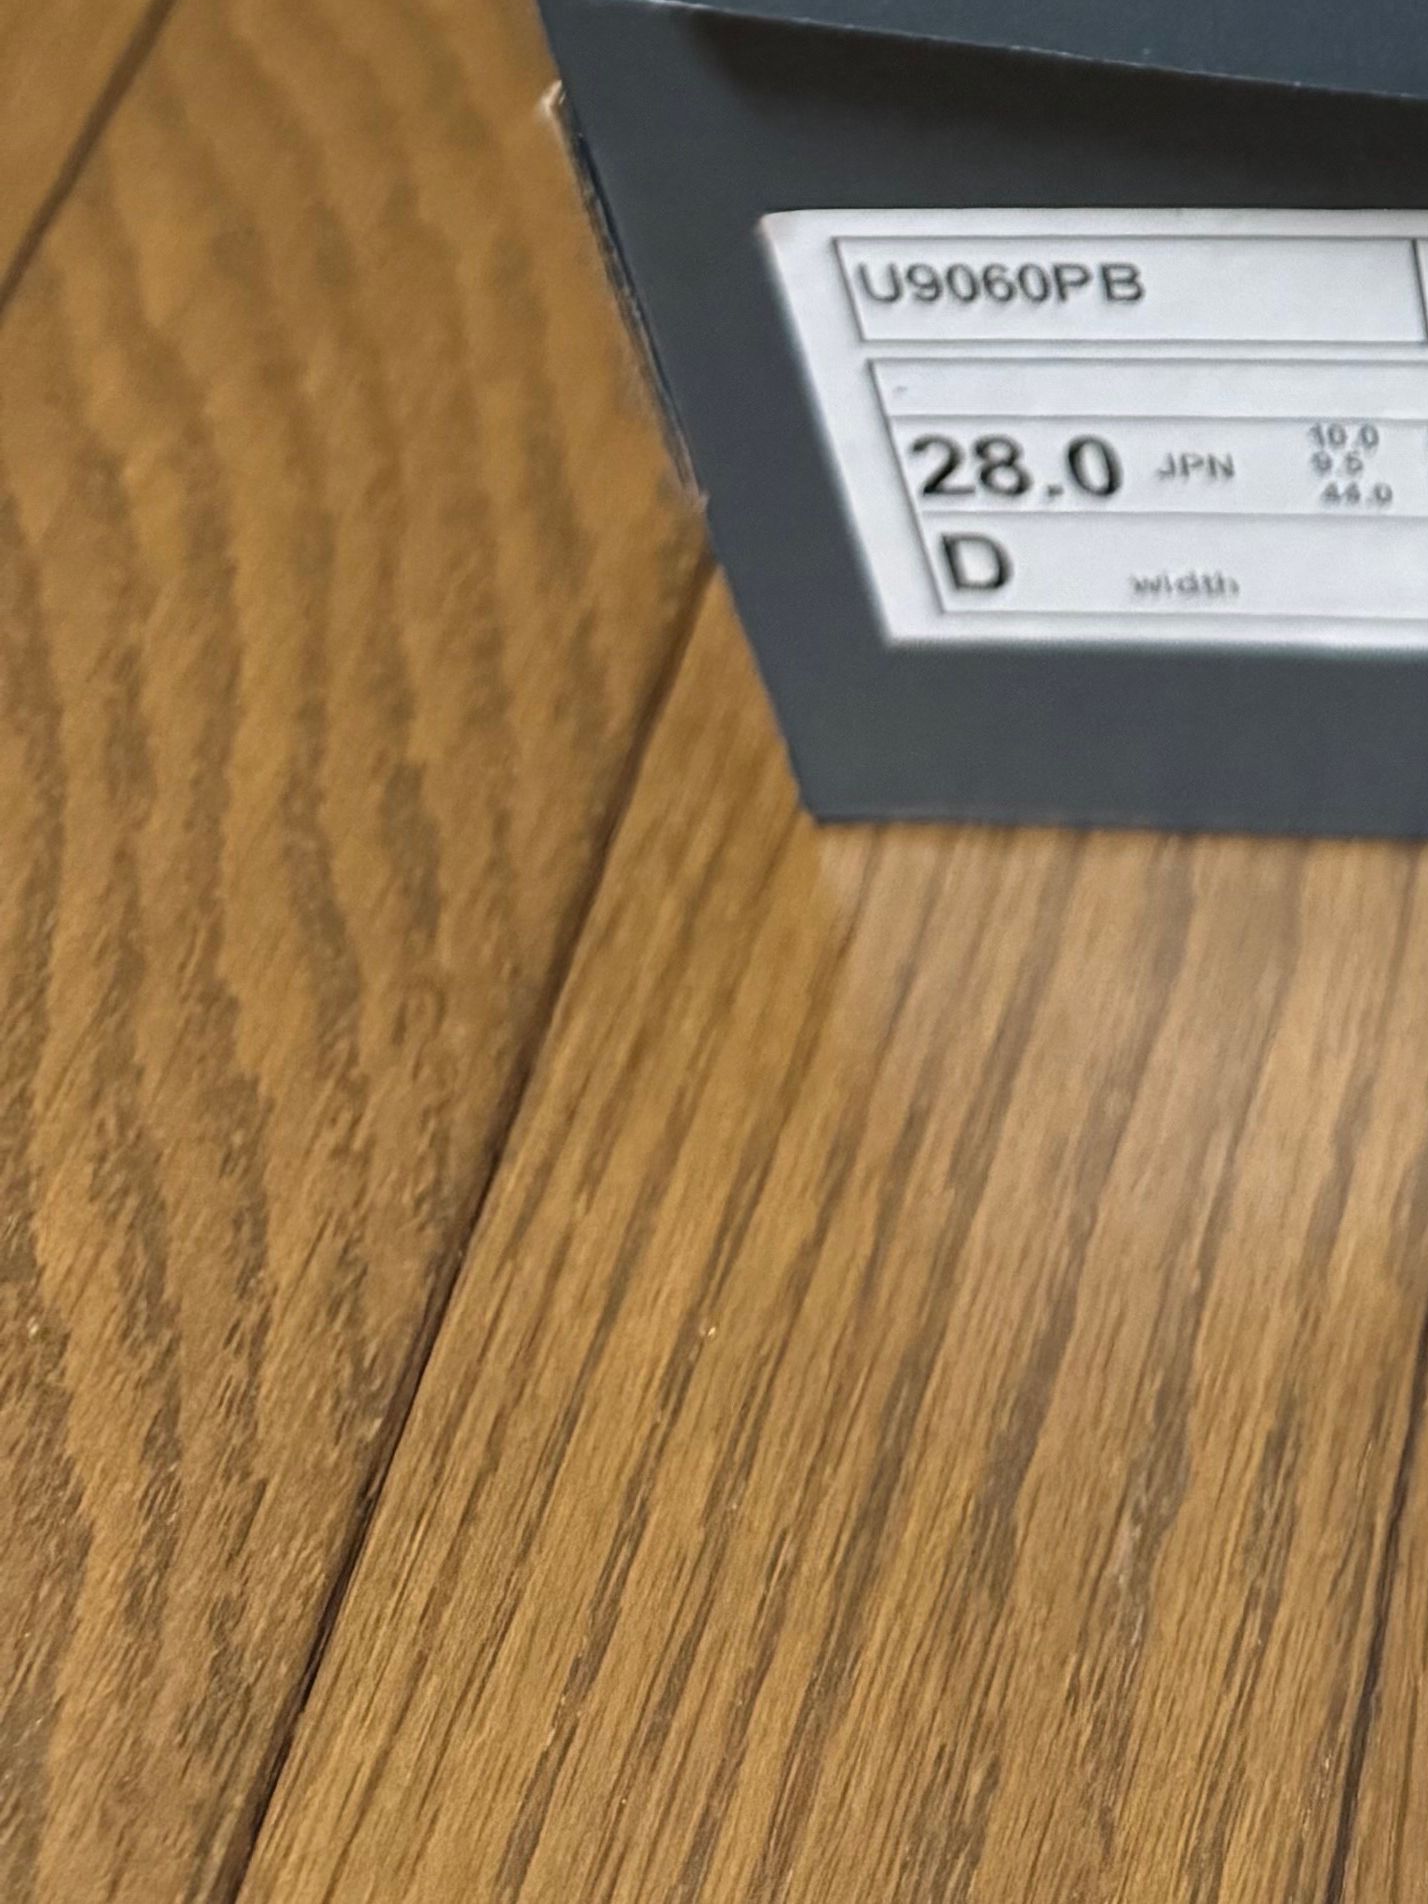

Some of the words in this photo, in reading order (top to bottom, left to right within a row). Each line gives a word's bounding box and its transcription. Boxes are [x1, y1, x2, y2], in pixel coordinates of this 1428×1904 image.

[857, 260, 1145, 305] U9060PB
[1308, 423, 1379, 449] 10.0
[908, 435, 1123, 499] 28.0
[1156, 452, 1236, 480] JPN
[942, 534, 1013, 592] D
[1132, 572, 1239, 598] width
